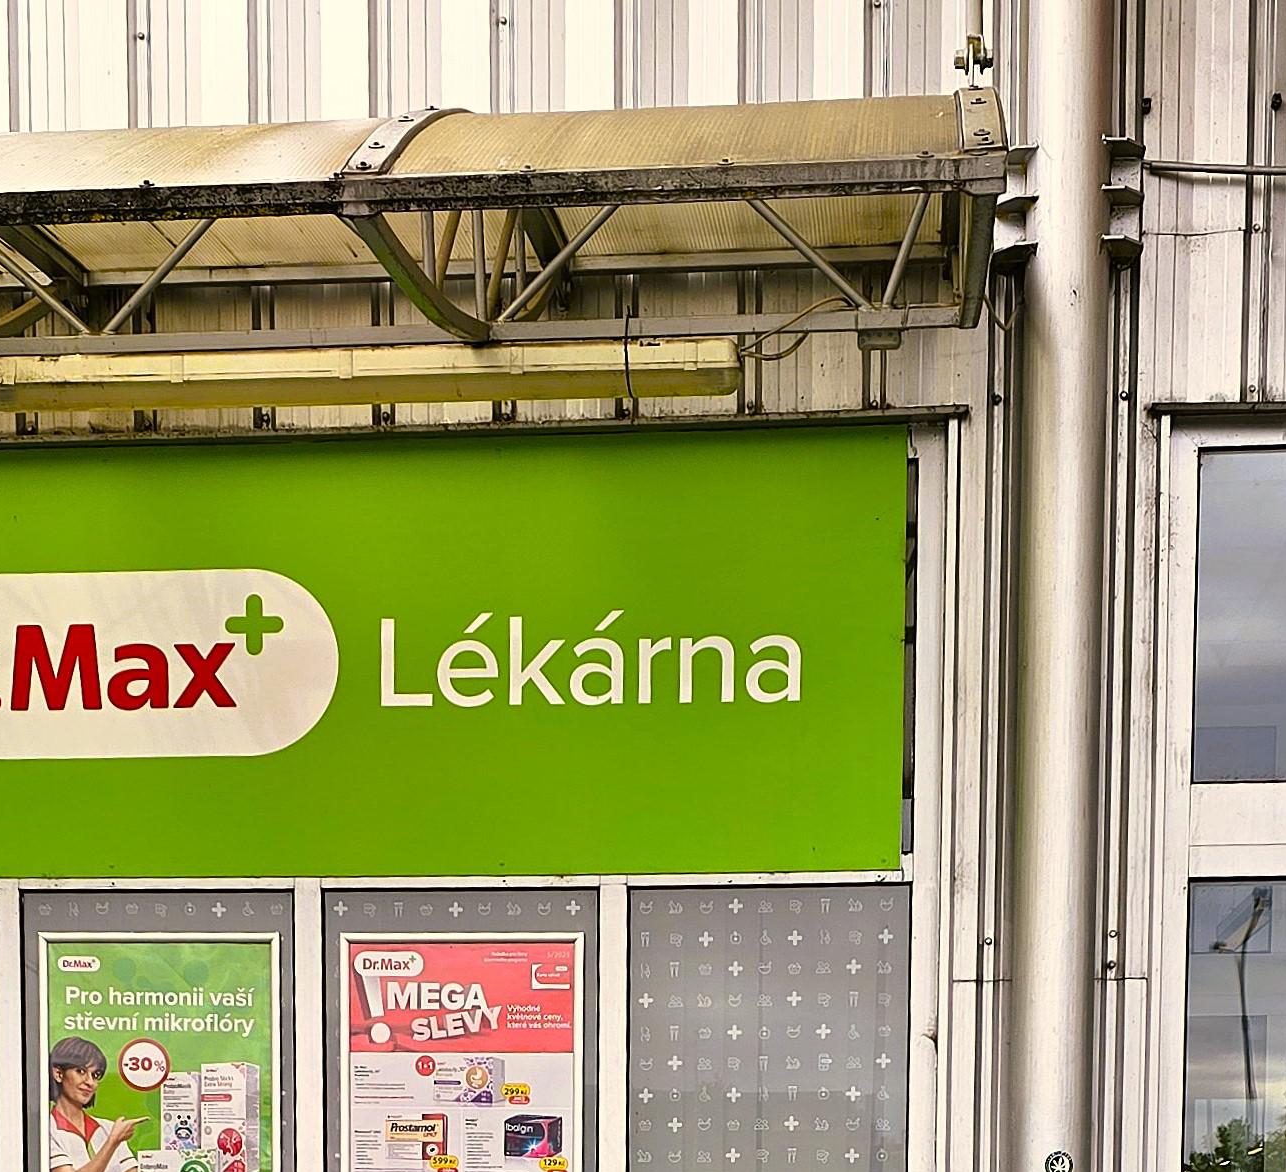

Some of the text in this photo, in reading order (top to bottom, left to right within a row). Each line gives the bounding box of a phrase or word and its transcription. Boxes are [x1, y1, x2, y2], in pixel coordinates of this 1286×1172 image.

[380, 609, 802, 708] Lékárna
[362, 957, 411, 971] Dr.Max
[65, 986, 256, 1007] Pro harmonii vaší
[386, 981, 489, 1011] MEGA
[506, 1004, 541, 1014] Výhodné
[64, 1012, 255, 1038] střevní mikroflóry
[410, 1004, 503, 1042] SLEVY
[503, 1087, 520, 1096] 299
[390, 1122, 436, 1133] Prostamol
[432, 1156, 449, 1165] 599
[543, 1158, 558, 1166] 129
